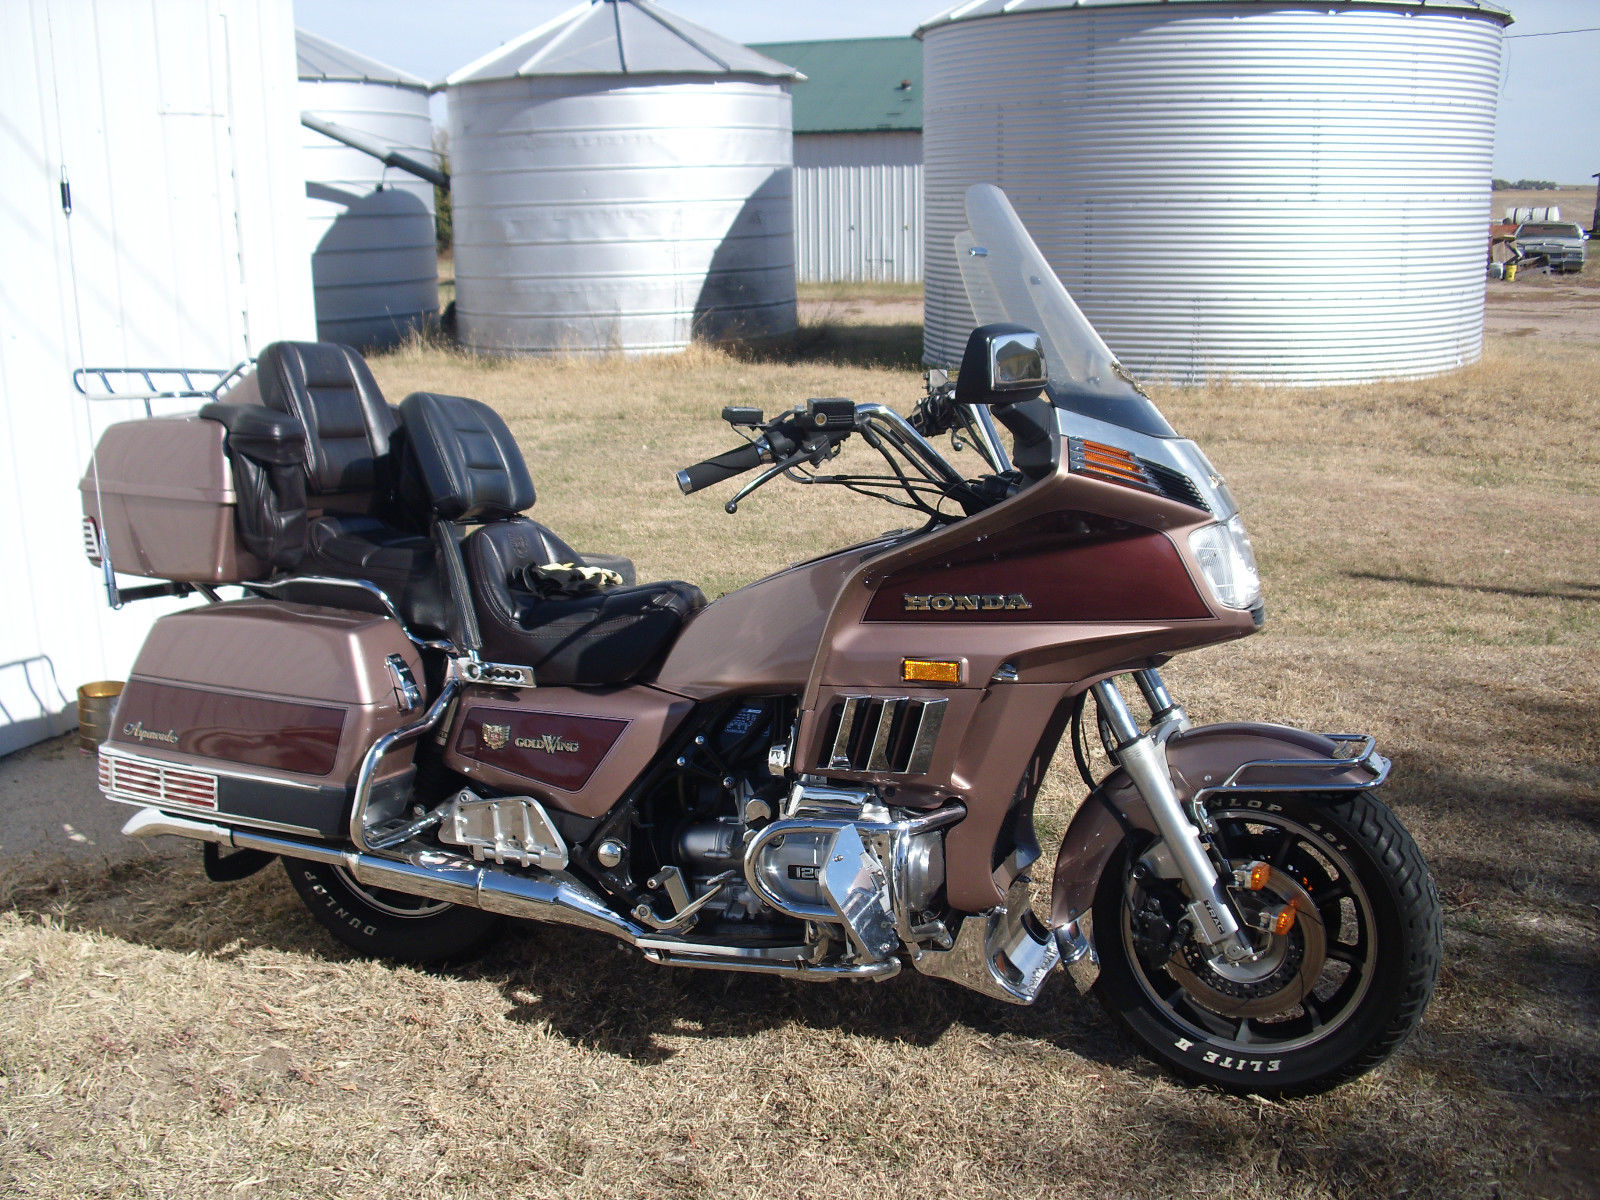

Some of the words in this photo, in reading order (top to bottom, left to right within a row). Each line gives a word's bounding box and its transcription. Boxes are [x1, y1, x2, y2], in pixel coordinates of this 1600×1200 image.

[904, 593, 1033, 611] HONDA
[514, 734, 579, 754] GOLDWING
[1208, 797, 1284, 812] NLOP
[304, 871, 377, 936] DUNLOP
[1203, 899, 1226, 935] TRAC
[1203, 1050, 1282, 1072] ELITE
